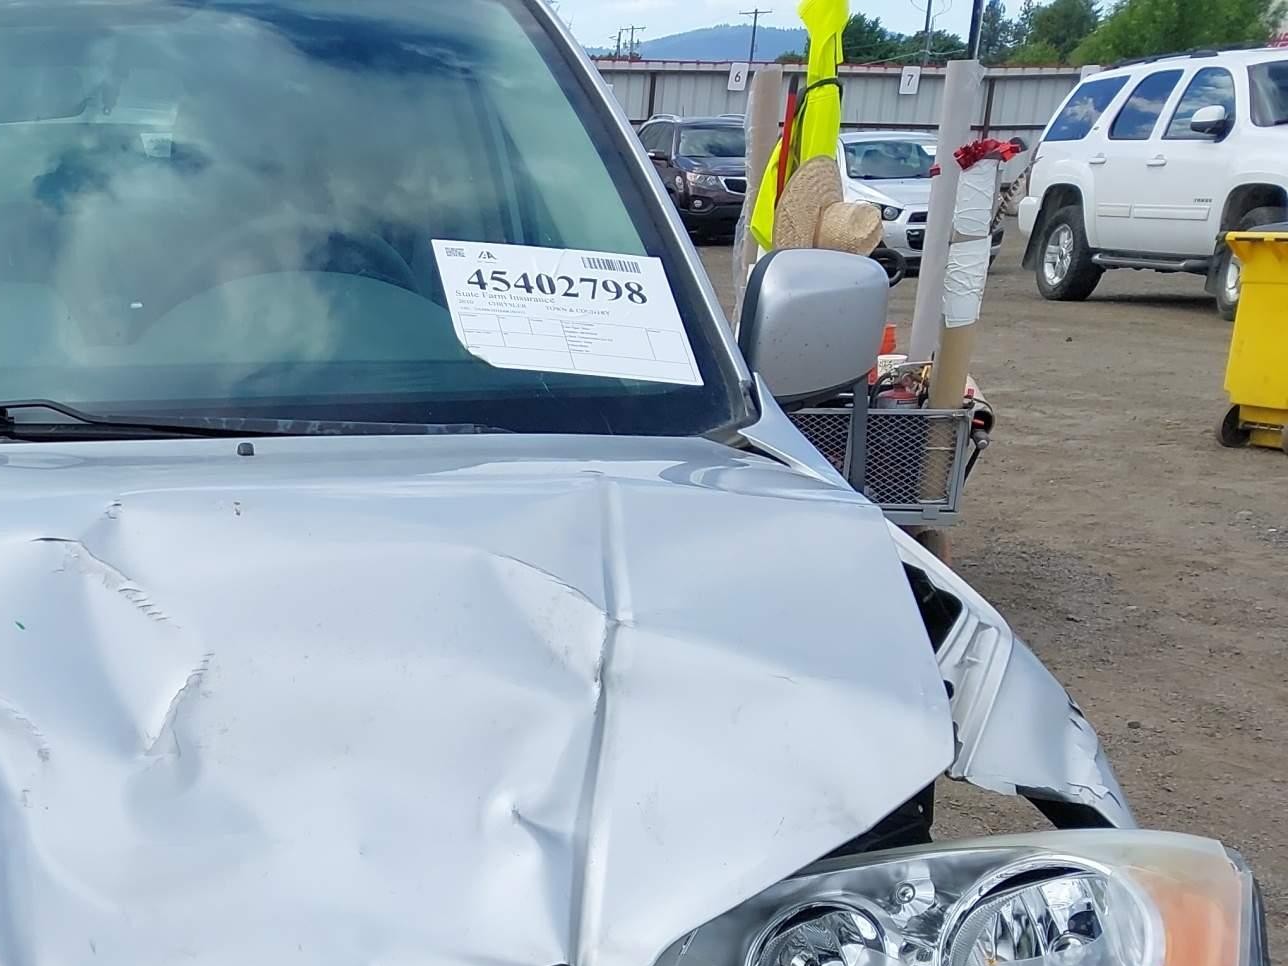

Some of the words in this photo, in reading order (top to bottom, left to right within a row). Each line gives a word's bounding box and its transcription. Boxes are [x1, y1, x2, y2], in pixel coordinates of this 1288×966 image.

[734, 71, 741, 83] 6
[907, 73, 914, 87] 7
[467, 268, 648, 305] 45402798
[455, 290, 479, 299] State
[482, 292, 507, 300] Farm
[509, 294, 556, 304] Insurance
